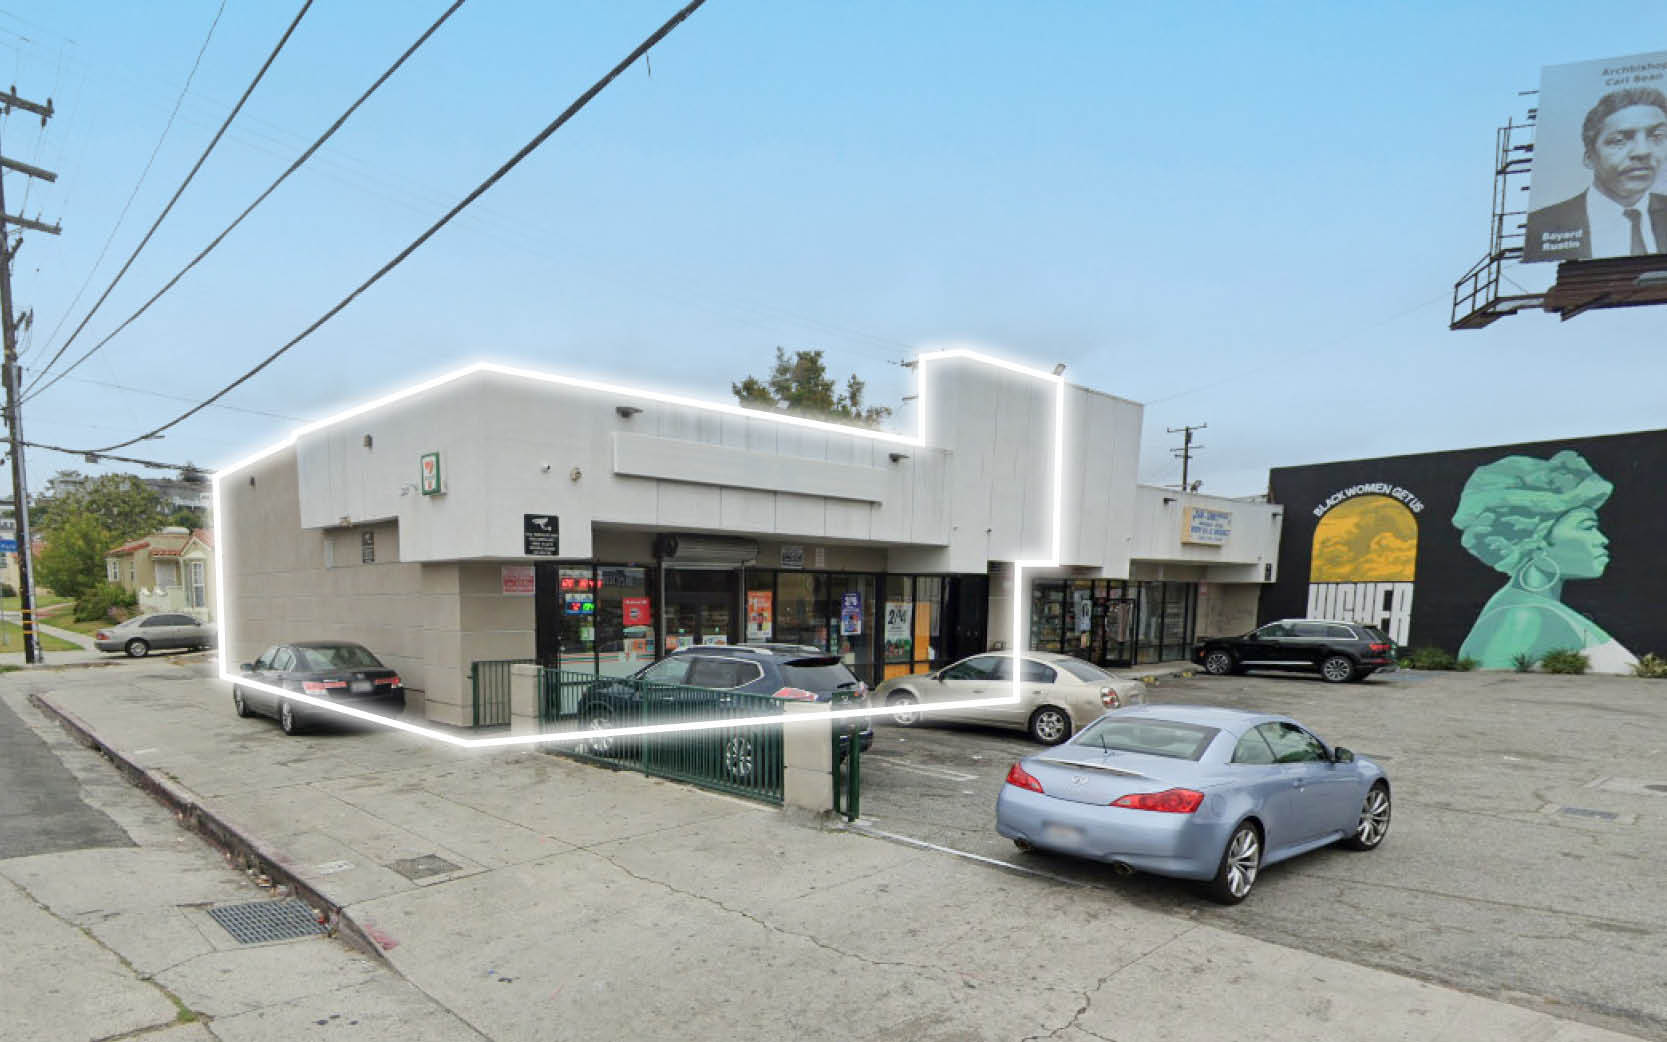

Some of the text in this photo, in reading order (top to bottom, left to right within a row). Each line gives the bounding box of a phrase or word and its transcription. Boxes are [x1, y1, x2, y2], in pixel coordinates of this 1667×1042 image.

[1313, 483, 1425, 517] BLACK WOMEN GET US
